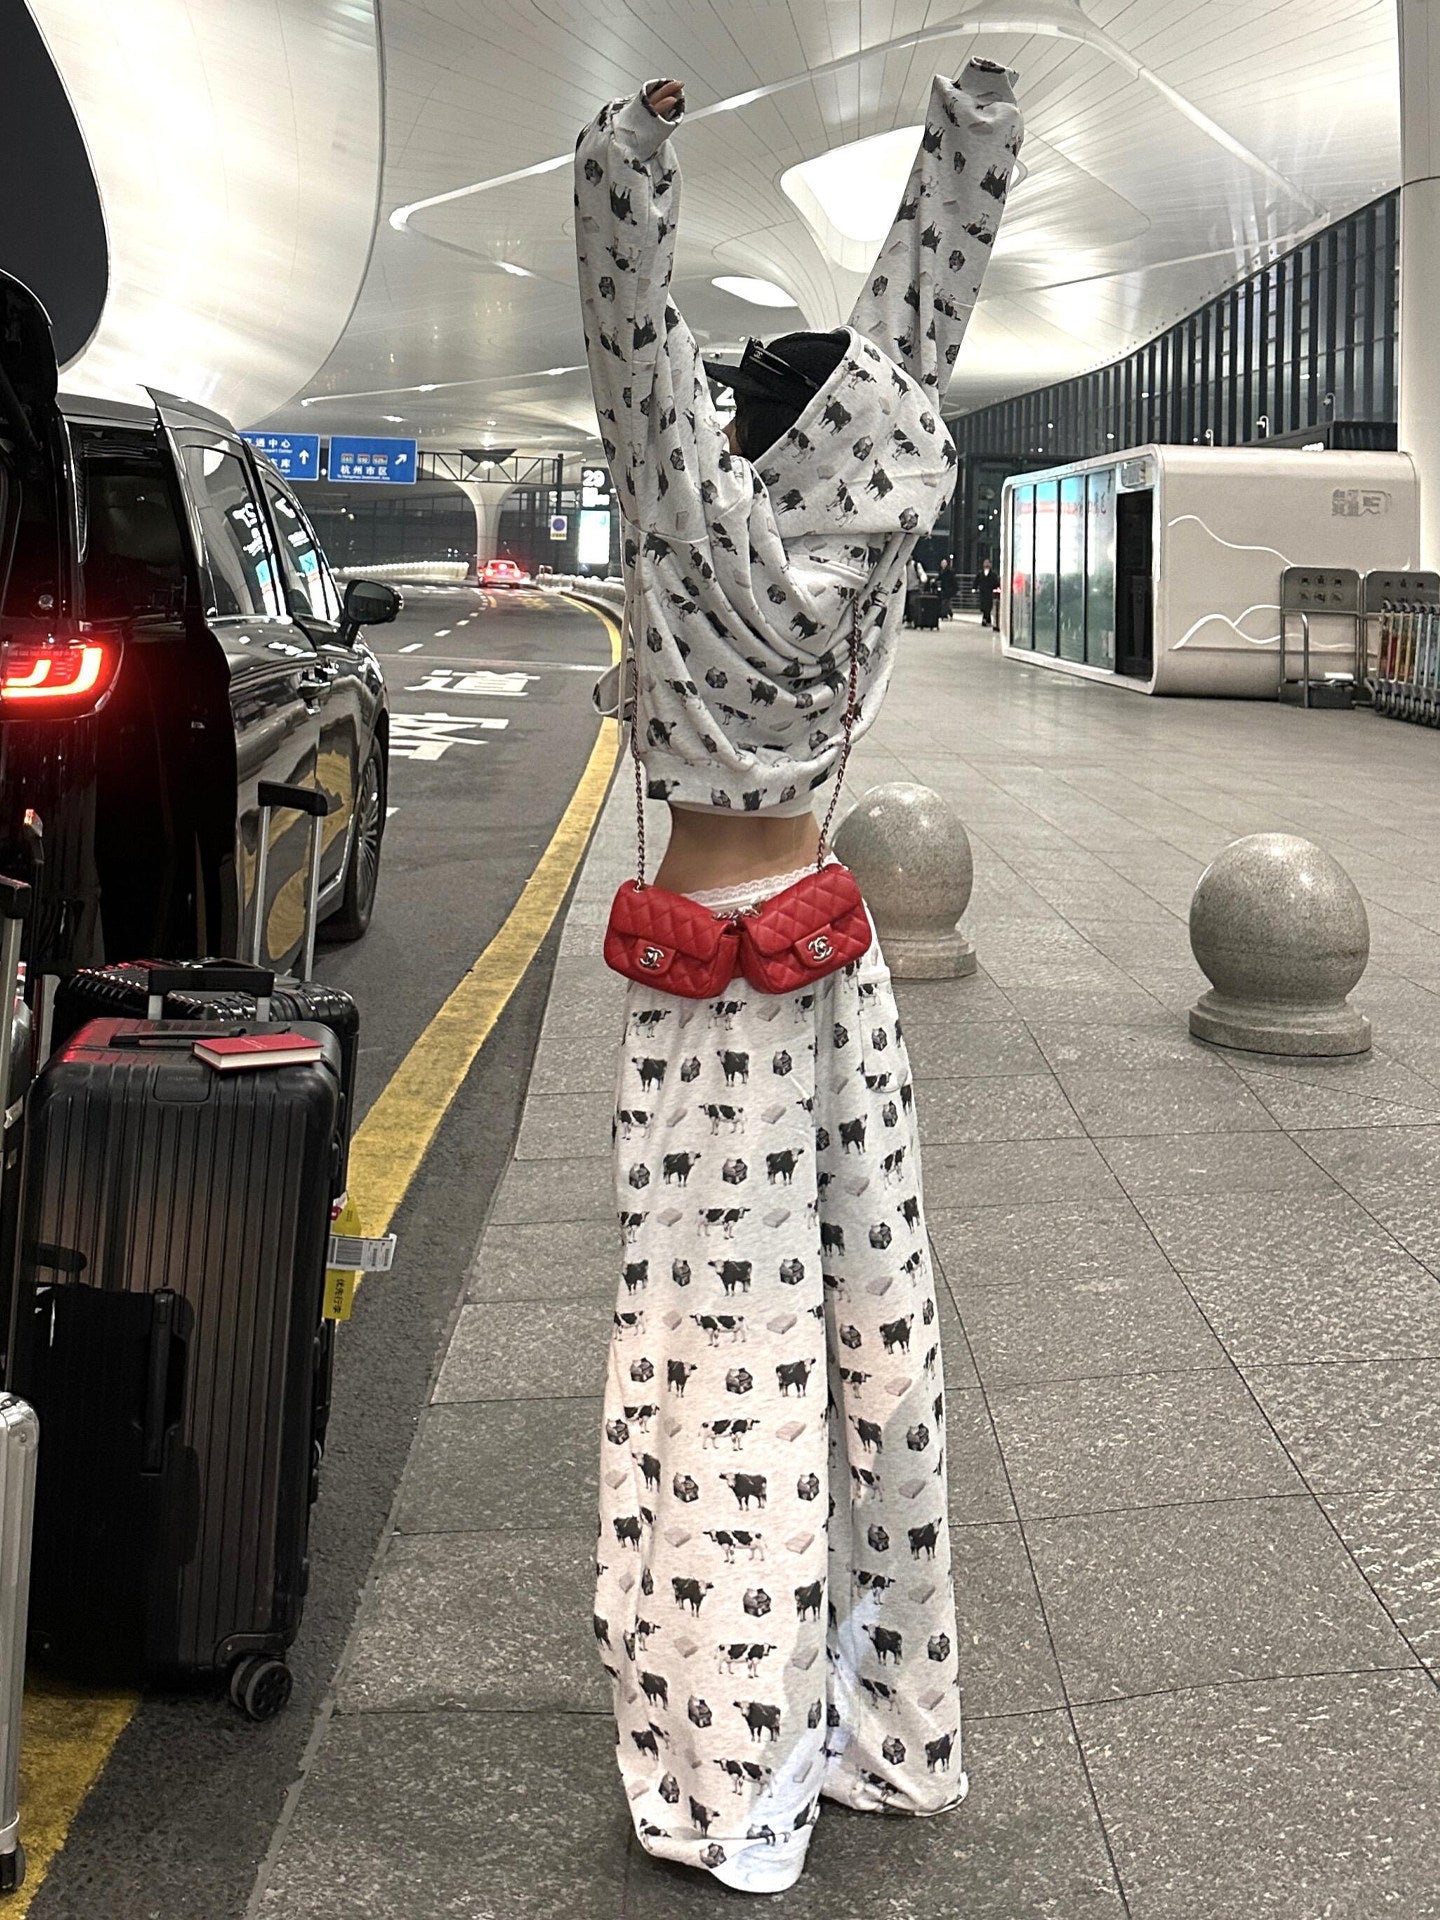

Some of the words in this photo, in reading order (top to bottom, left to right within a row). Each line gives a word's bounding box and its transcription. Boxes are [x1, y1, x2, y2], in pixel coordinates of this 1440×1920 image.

[340, 465, 388, 476] 杭州市区
[404, 669, 541, 697] 道
